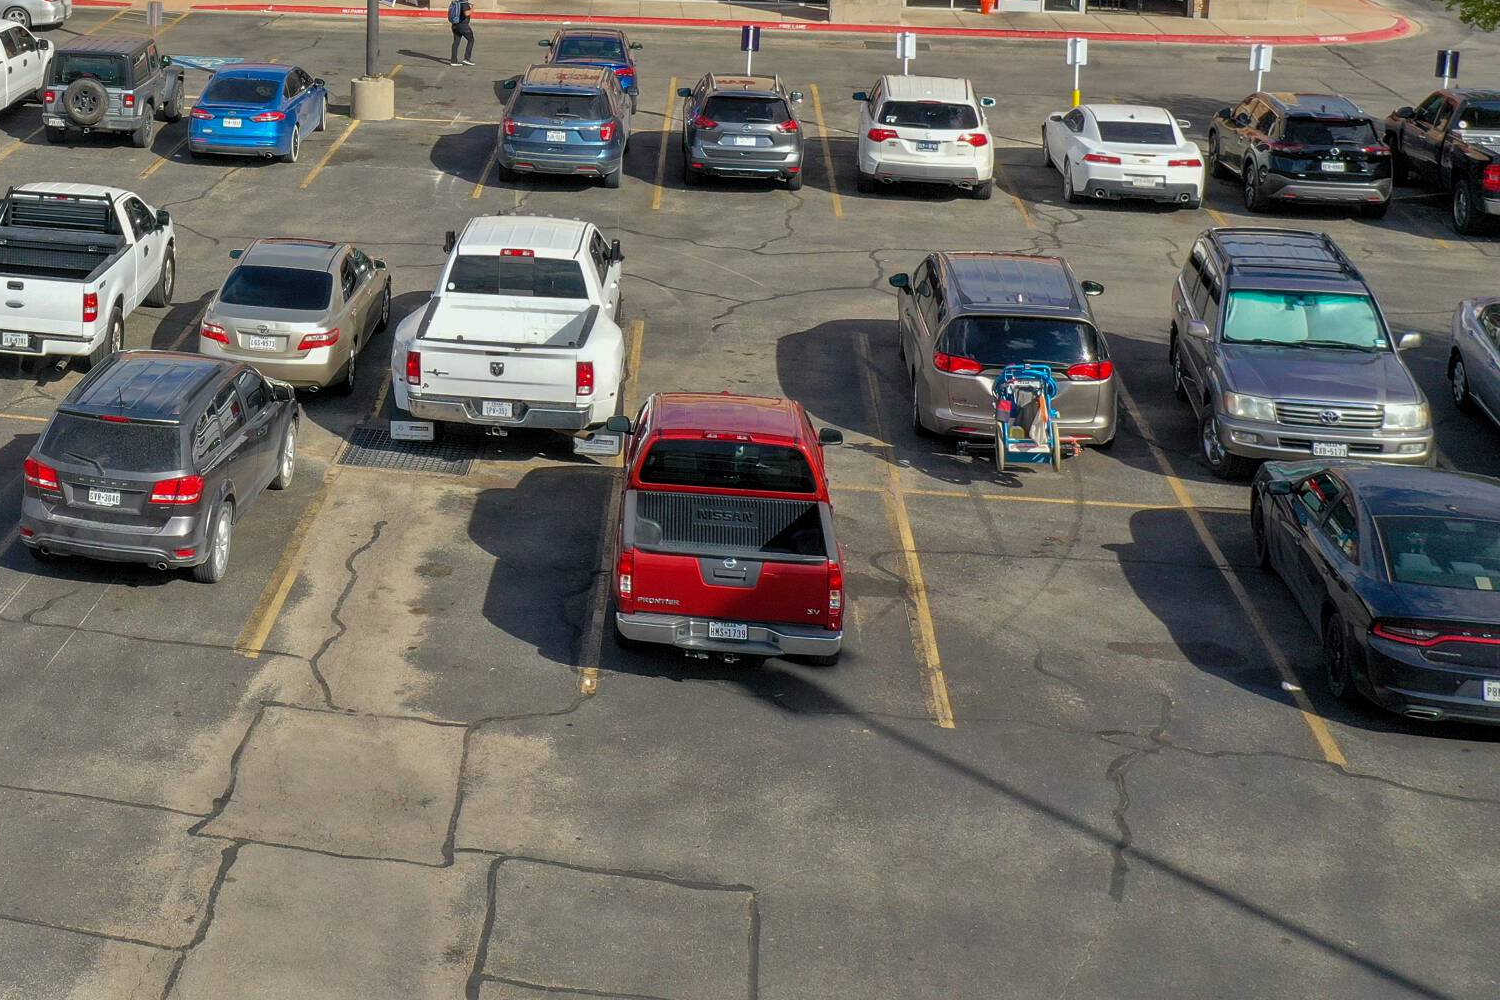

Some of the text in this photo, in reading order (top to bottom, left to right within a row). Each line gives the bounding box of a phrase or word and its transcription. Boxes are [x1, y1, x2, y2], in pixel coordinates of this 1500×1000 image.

[696, 509, 755, 523] NISSAN
[637, 596, 681, 606] FRONTIER
[806, 608, 821, 616] SV
